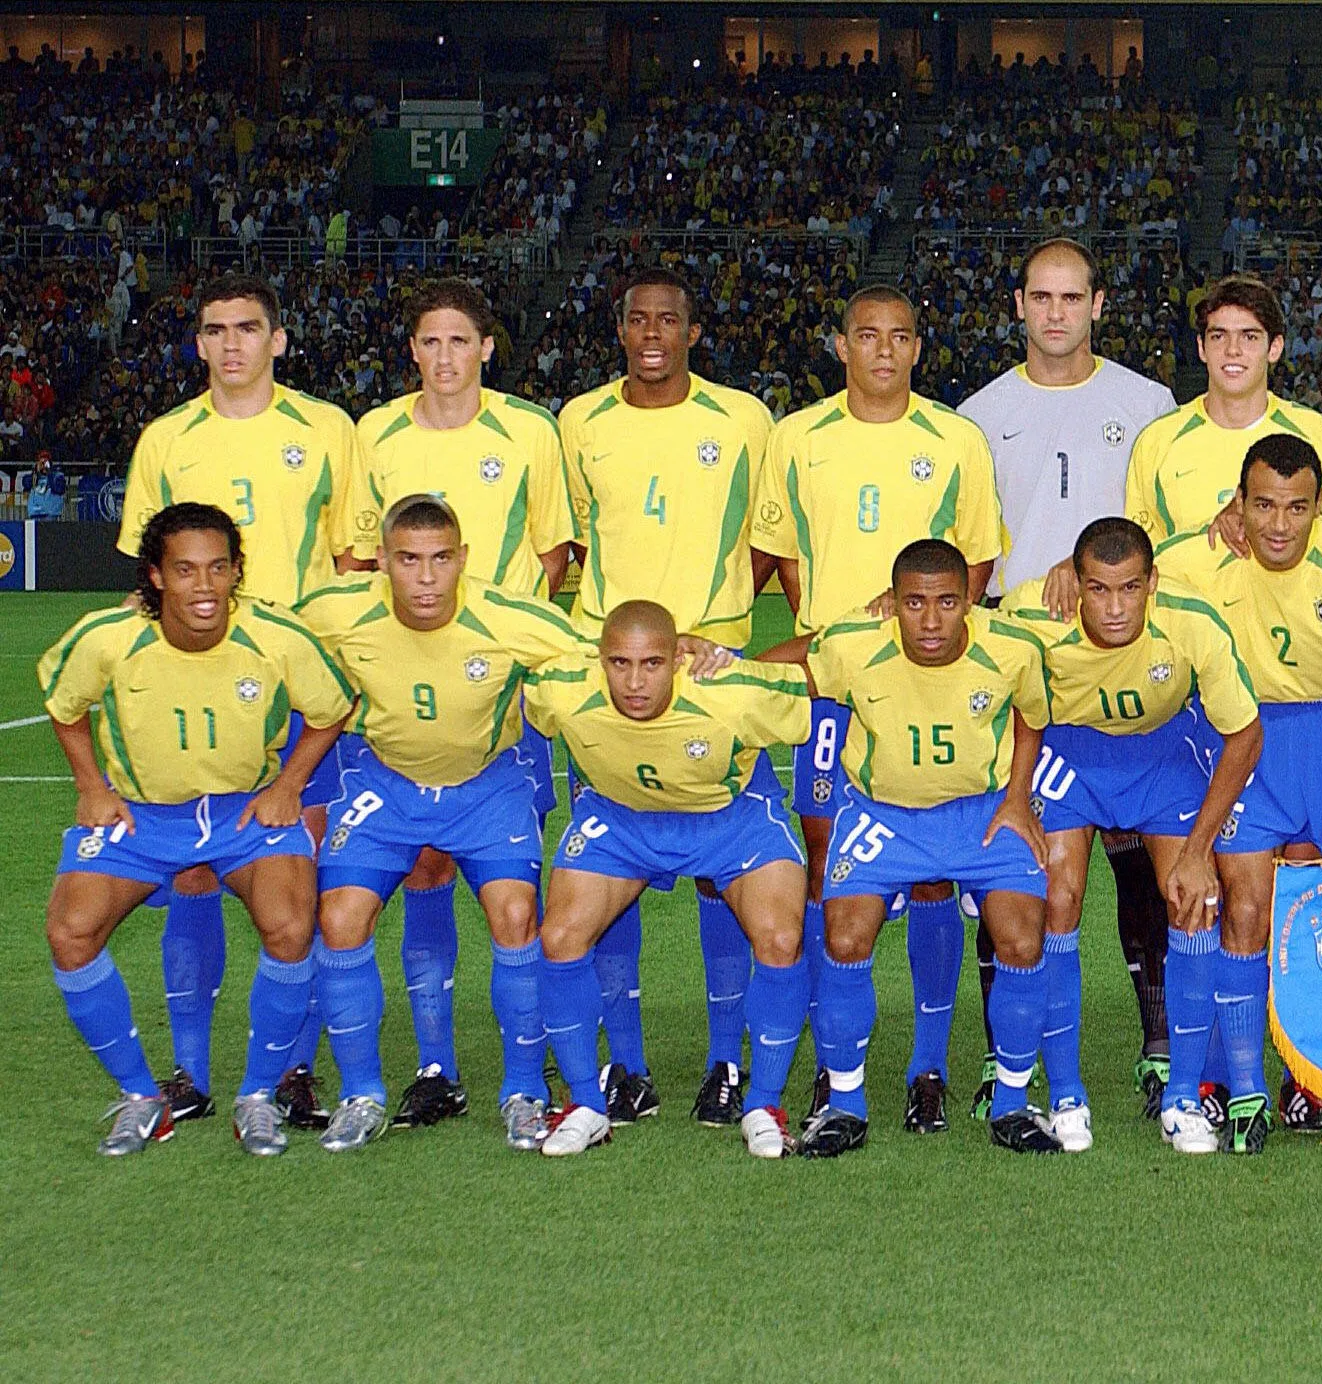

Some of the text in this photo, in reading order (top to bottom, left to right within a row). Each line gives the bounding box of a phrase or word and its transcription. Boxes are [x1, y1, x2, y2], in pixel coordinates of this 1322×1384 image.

[410, 129, 469, 169] E14
[1056, 451, 1069, 499] 1
[231, 479, 255, 526] 3
[644, 475, 666, 525] 4
[857, 484, 881, 532] 8
[1270, 626, 1298, 667] 2
[412, 683, 437, 721] 9
[1098, 686, 1146, 720] 10
[174, 707, 217, 750] 11
[813, 717, 837, 772] 8
[908, 724, 955, 766] 15
[636, 763, 662, 791] 6
[340, 790, 384, 827] 9
[838, 812, 896, 863] 15
